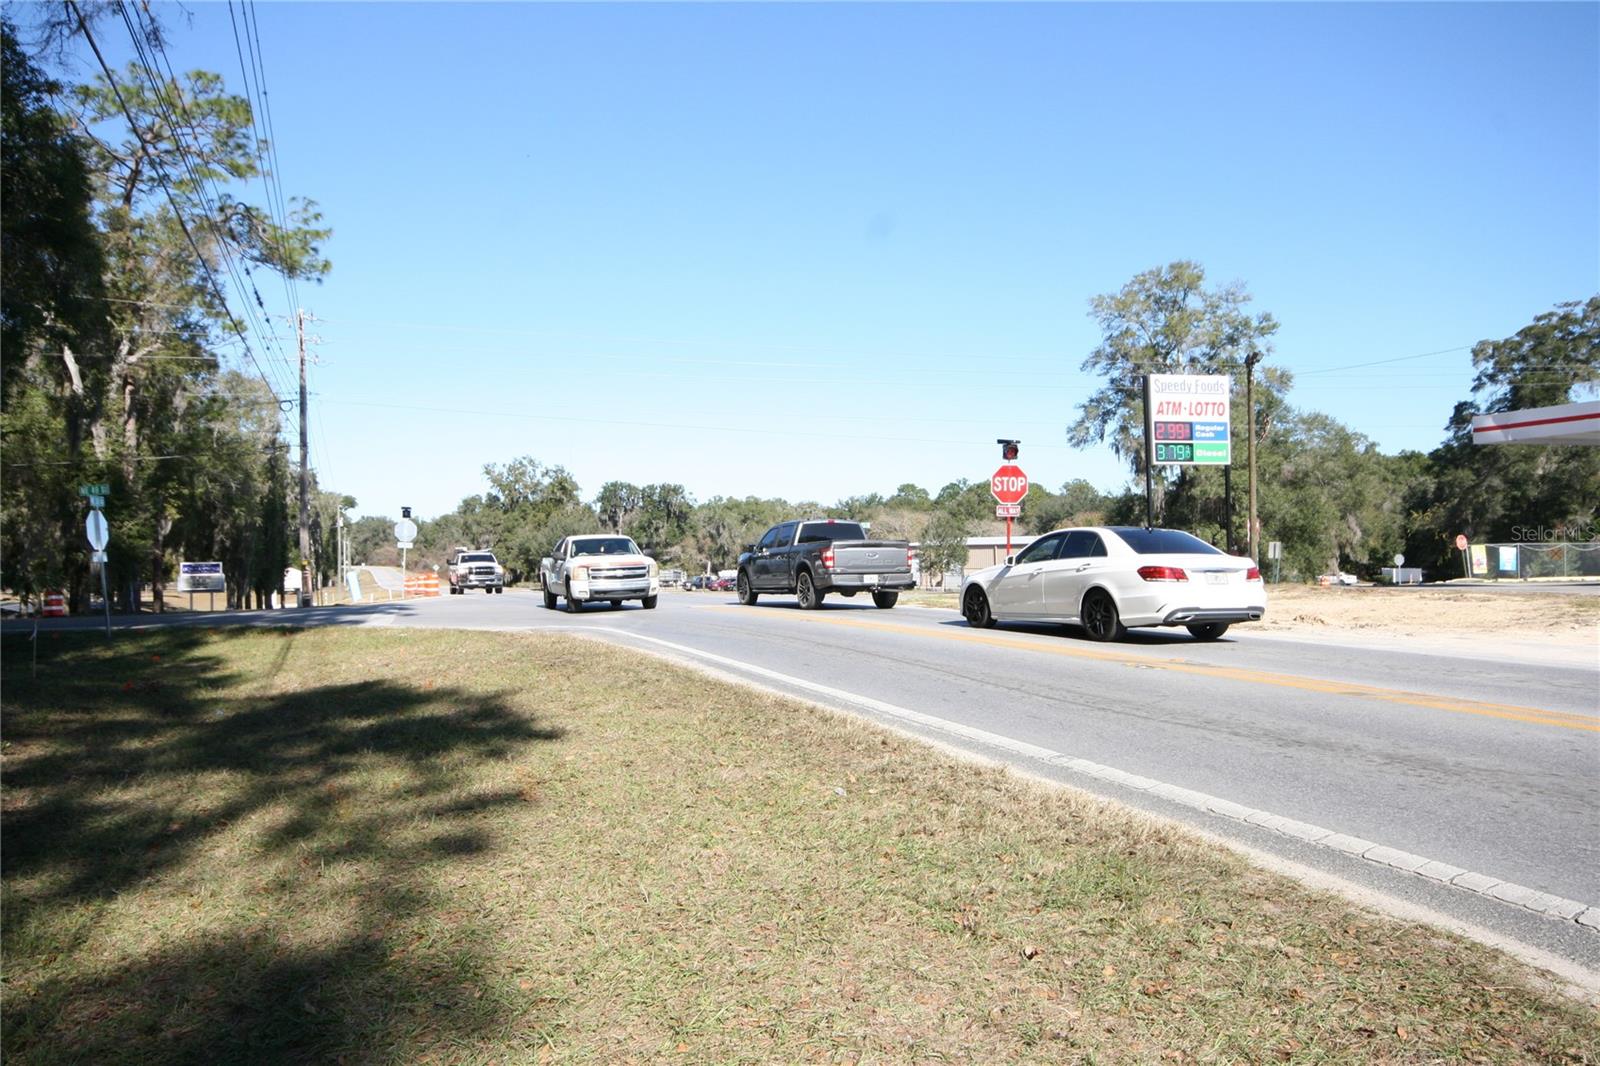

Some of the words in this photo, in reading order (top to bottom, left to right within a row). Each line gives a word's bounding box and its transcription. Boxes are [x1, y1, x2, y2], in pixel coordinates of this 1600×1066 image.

[1153, 378, 1192, 394] Speedy
[1194, 379, 1225, 395] Foods
[1156, 401, 1182, 416] ATM
[1188, 402, 1226, 417] LOTTO
[993, 476, 1026, 492] STOP
